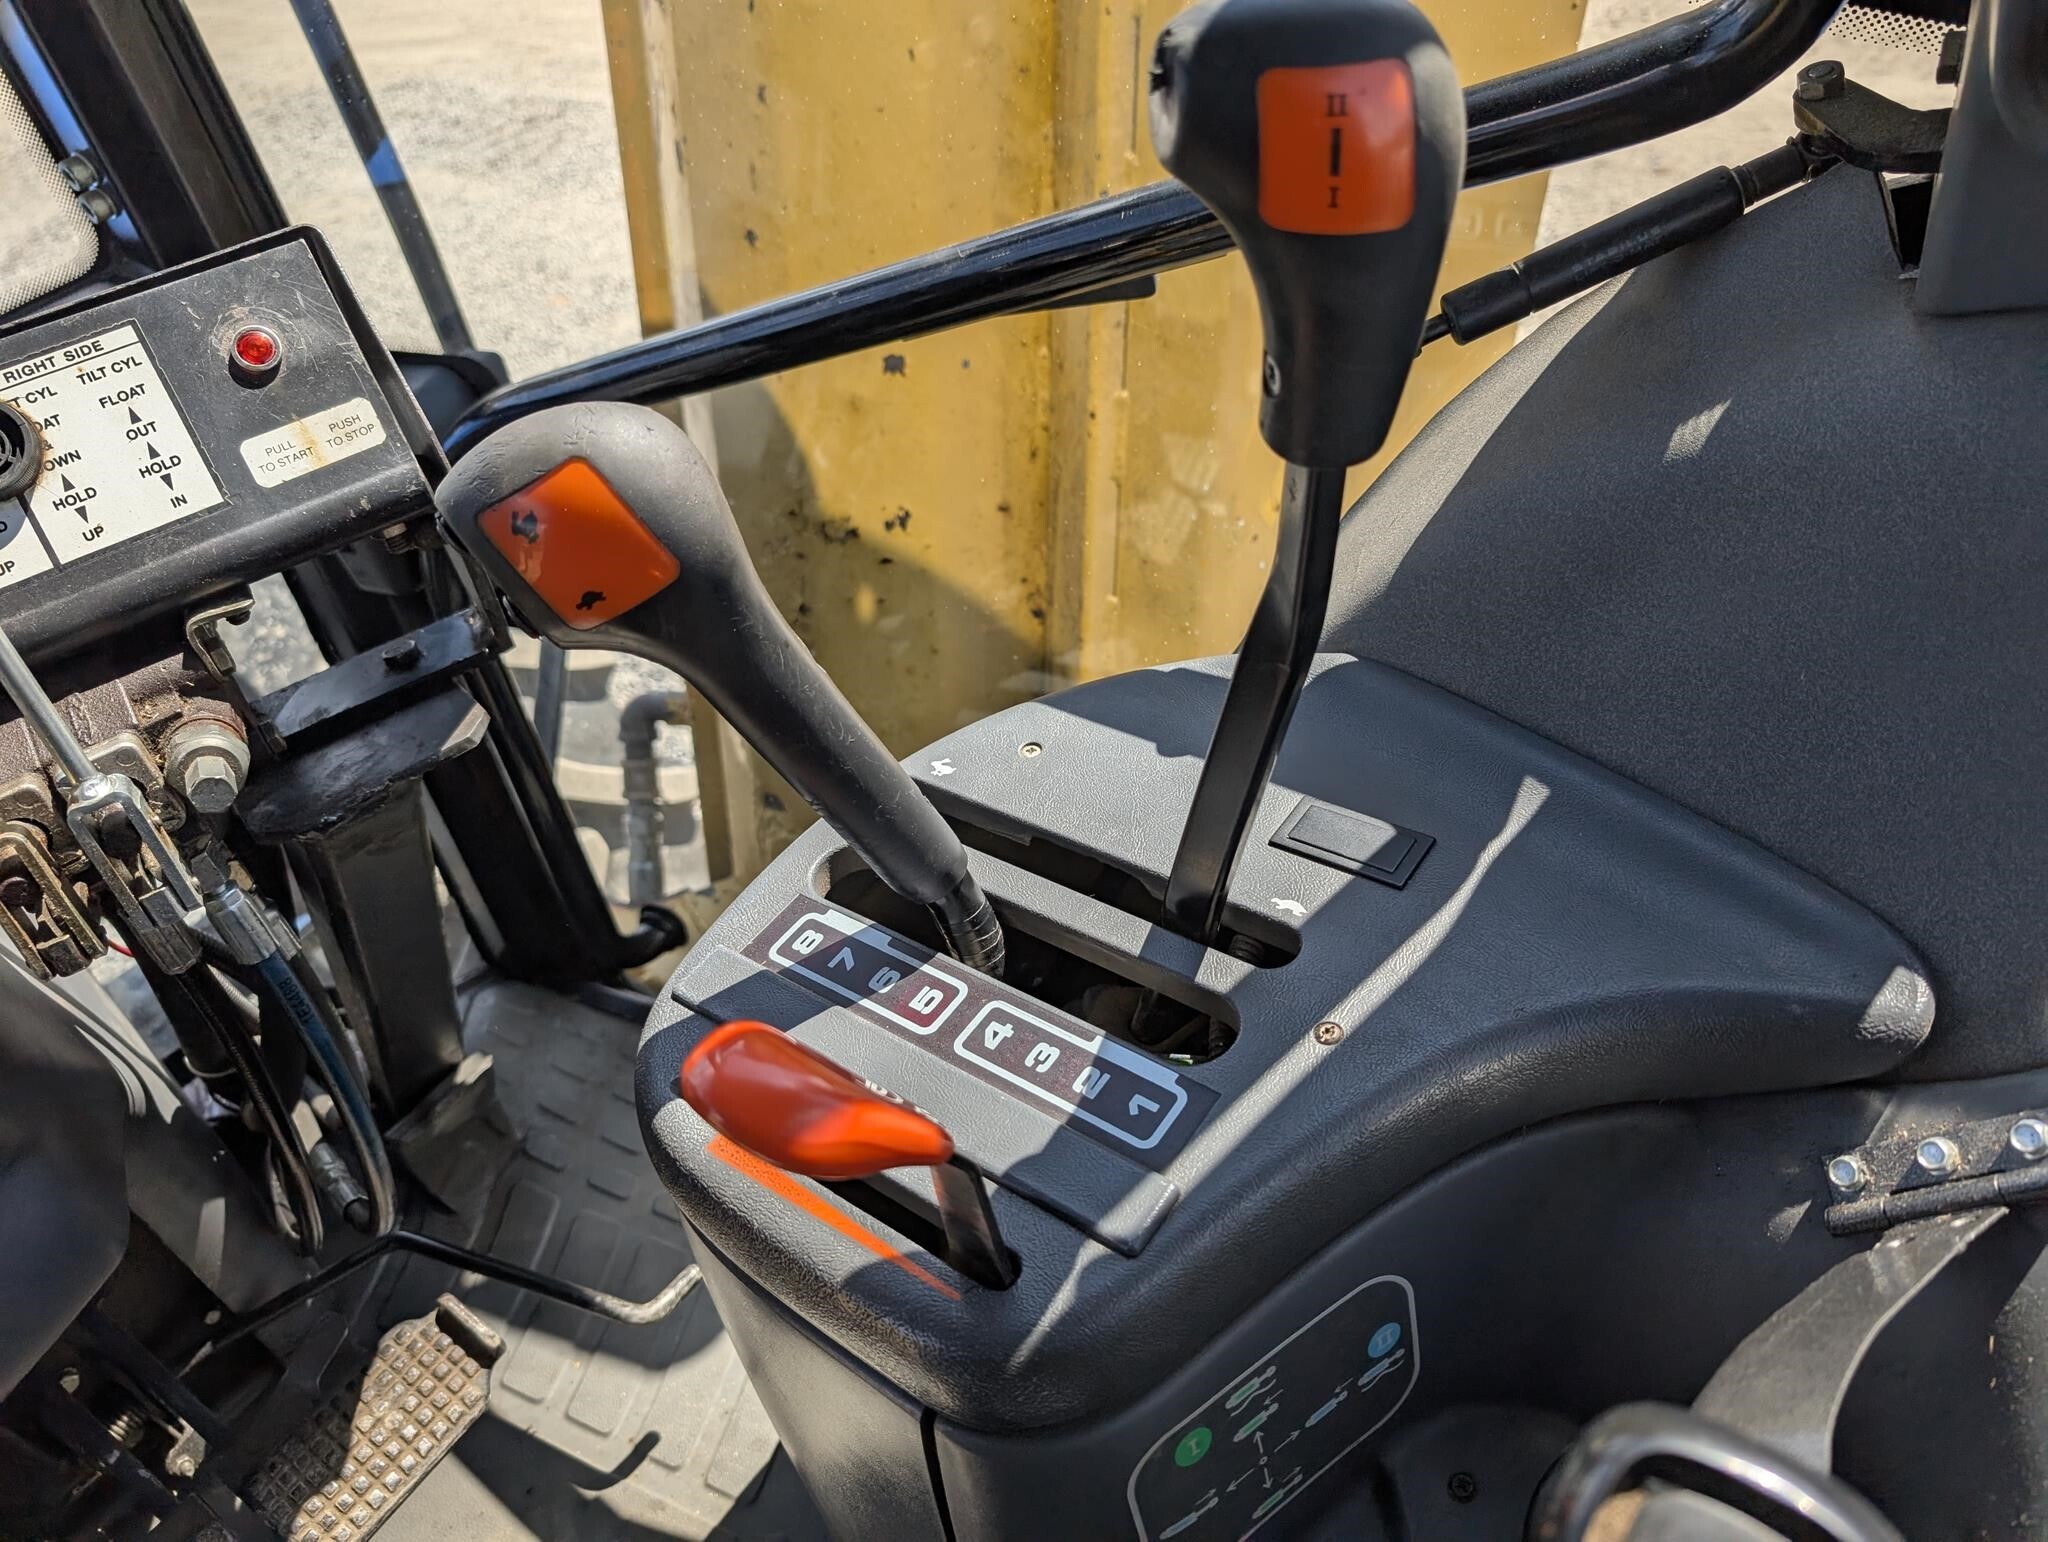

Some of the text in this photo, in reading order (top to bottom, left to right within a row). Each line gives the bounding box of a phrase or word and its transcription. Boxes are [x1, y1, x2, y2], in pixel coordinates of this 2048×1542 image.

[2, 340, 105, 383] RIGHT SIDE
[76, 356, 143, 385] TILT CYL
[25, 386, 58, 404] CYL
[98, 383, 147, 408] FLOAT
[126, 421, 157, 441] OUT
[328, 414, 362, 433] PUSH
[326, 423, 376, 449] TO STOP
[264, 440, 297, 457] PULL
[41, 450, 82, 473] OWN
[138, 455, 182, 479] HOLD
[258, 447, 315, 475] TO START
[52, 487, 97, 511] HOLD
[170, 494, 188, 508] IN
[82, 526, 104, 541] UP
[791, 929, 944, 1015] 8 7 6 5
[984, 1021, 1160, 1116] 4 3 2 1
